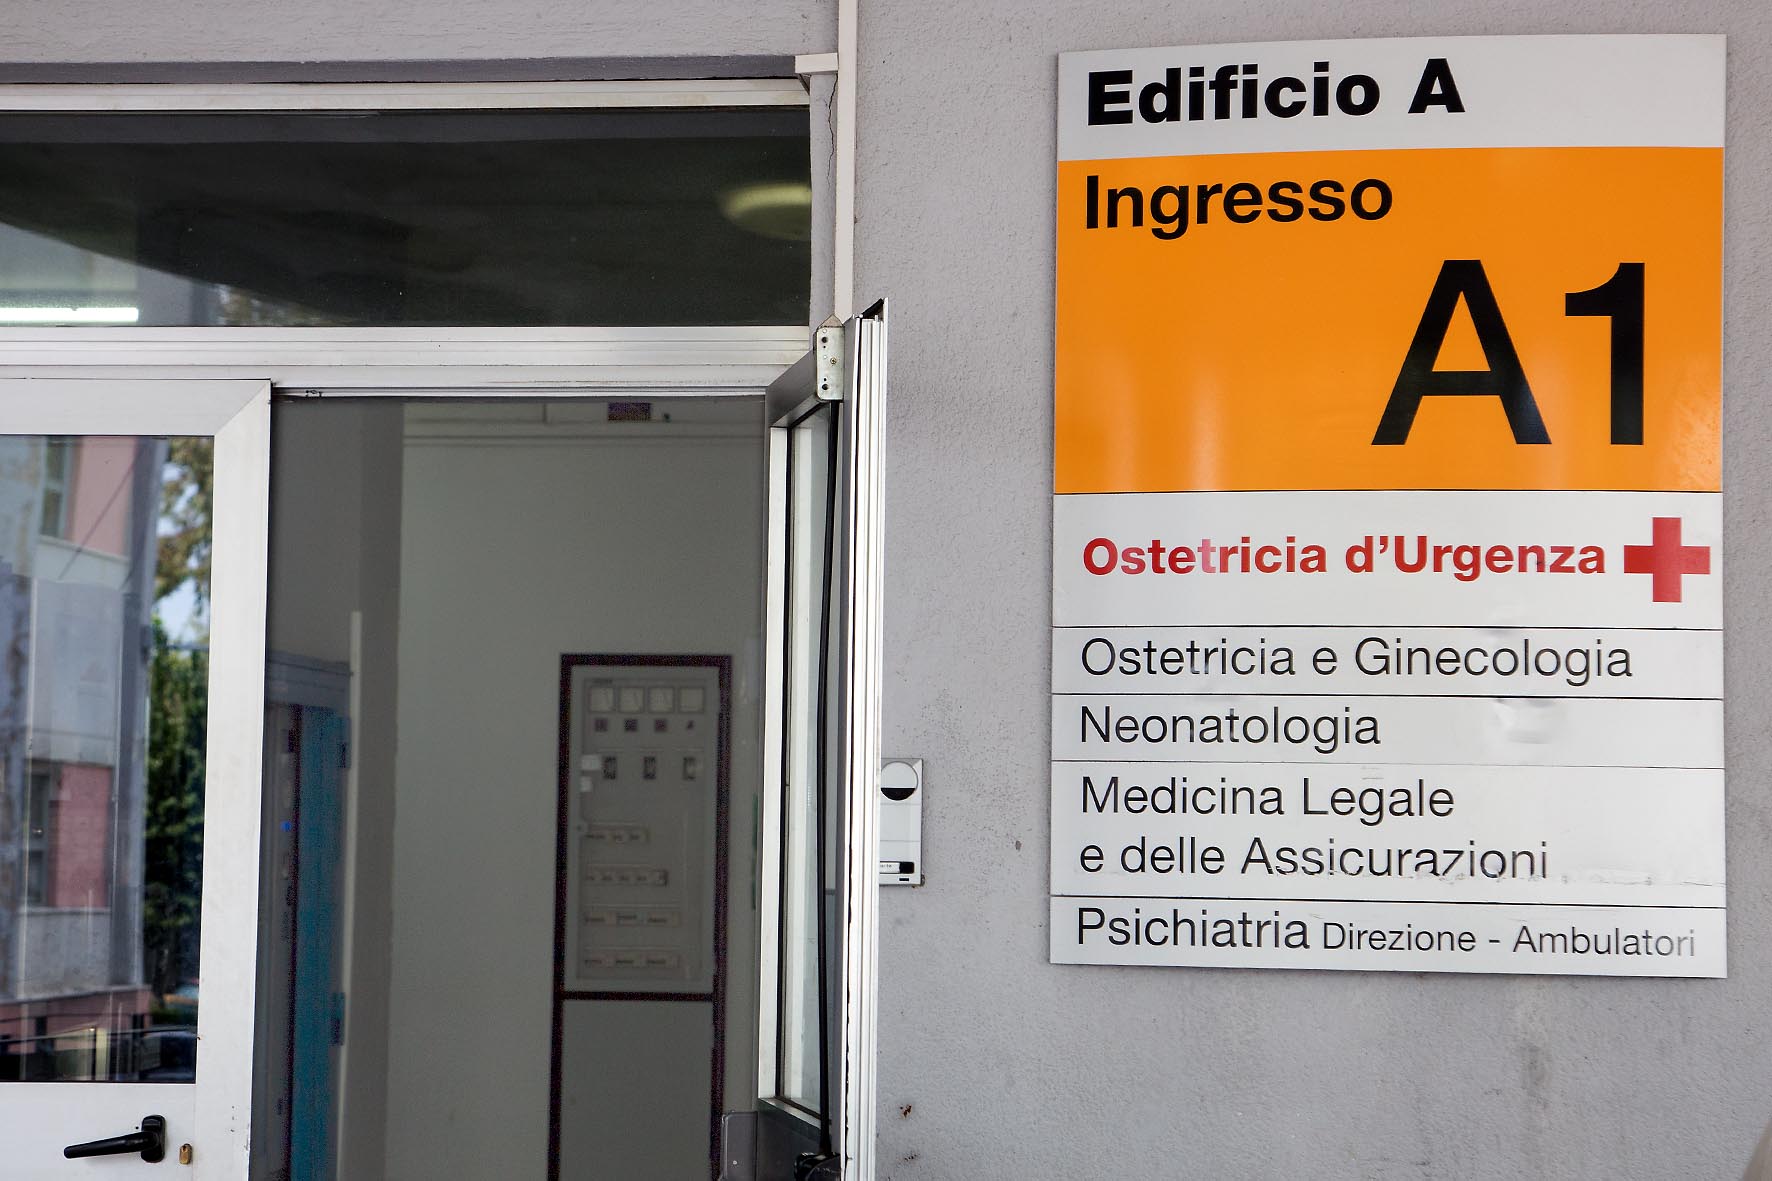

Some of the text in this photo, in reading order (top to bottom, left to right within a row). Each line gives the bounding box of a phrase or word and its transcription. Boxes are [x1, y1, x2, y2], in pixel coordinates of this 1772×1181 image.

[1088, 58, 1465, 126] Edificio A
[1087, 175, 1392, 240] Ingresso
[1371, 260, 1646, 446] A1
[1084, 537, 1326, 575] Ostetricia
[1081, 637, 1633, 686] Ostetricia e Ginecologia
[1081, 706, 1381, 754] Neonatologia
[1082, 776, 1455, 826] Medicina Legale
[1079, 836, 1547, 878] e delle Assicurazioni
[1078, 908, 1311, 949] Psichiatria
[1323, 923, 1477, 952] Direzione
[1512, 925, 1695, 958] Ambulatori
